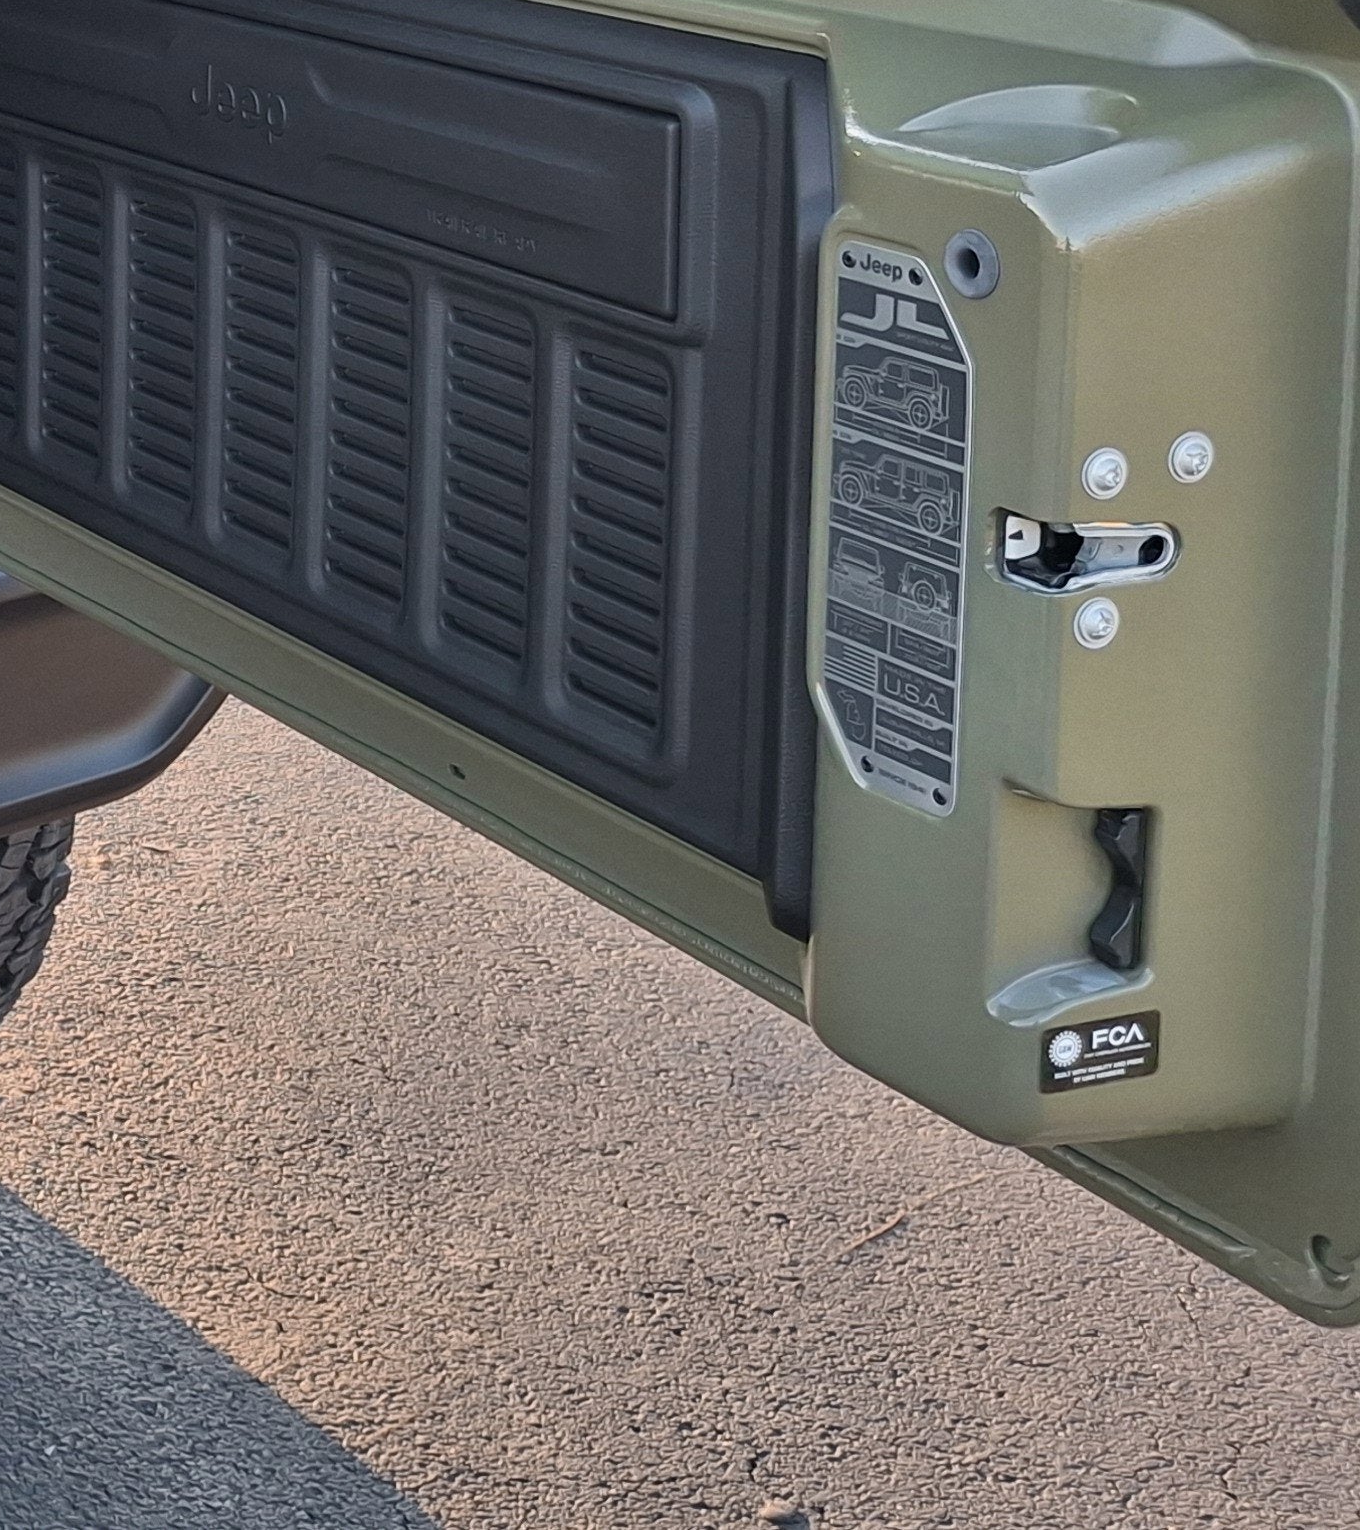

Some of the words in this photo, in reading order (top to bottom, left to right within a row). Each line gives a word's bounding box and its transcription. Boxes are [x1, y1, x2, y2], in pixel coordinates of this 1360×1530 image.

[191, 65, 287, 144] Jeep
[860, 253, 903, 283] Jeep
[840, 293, 950, 340] JL
[1092, 1022, 1145, 1050] FCA
